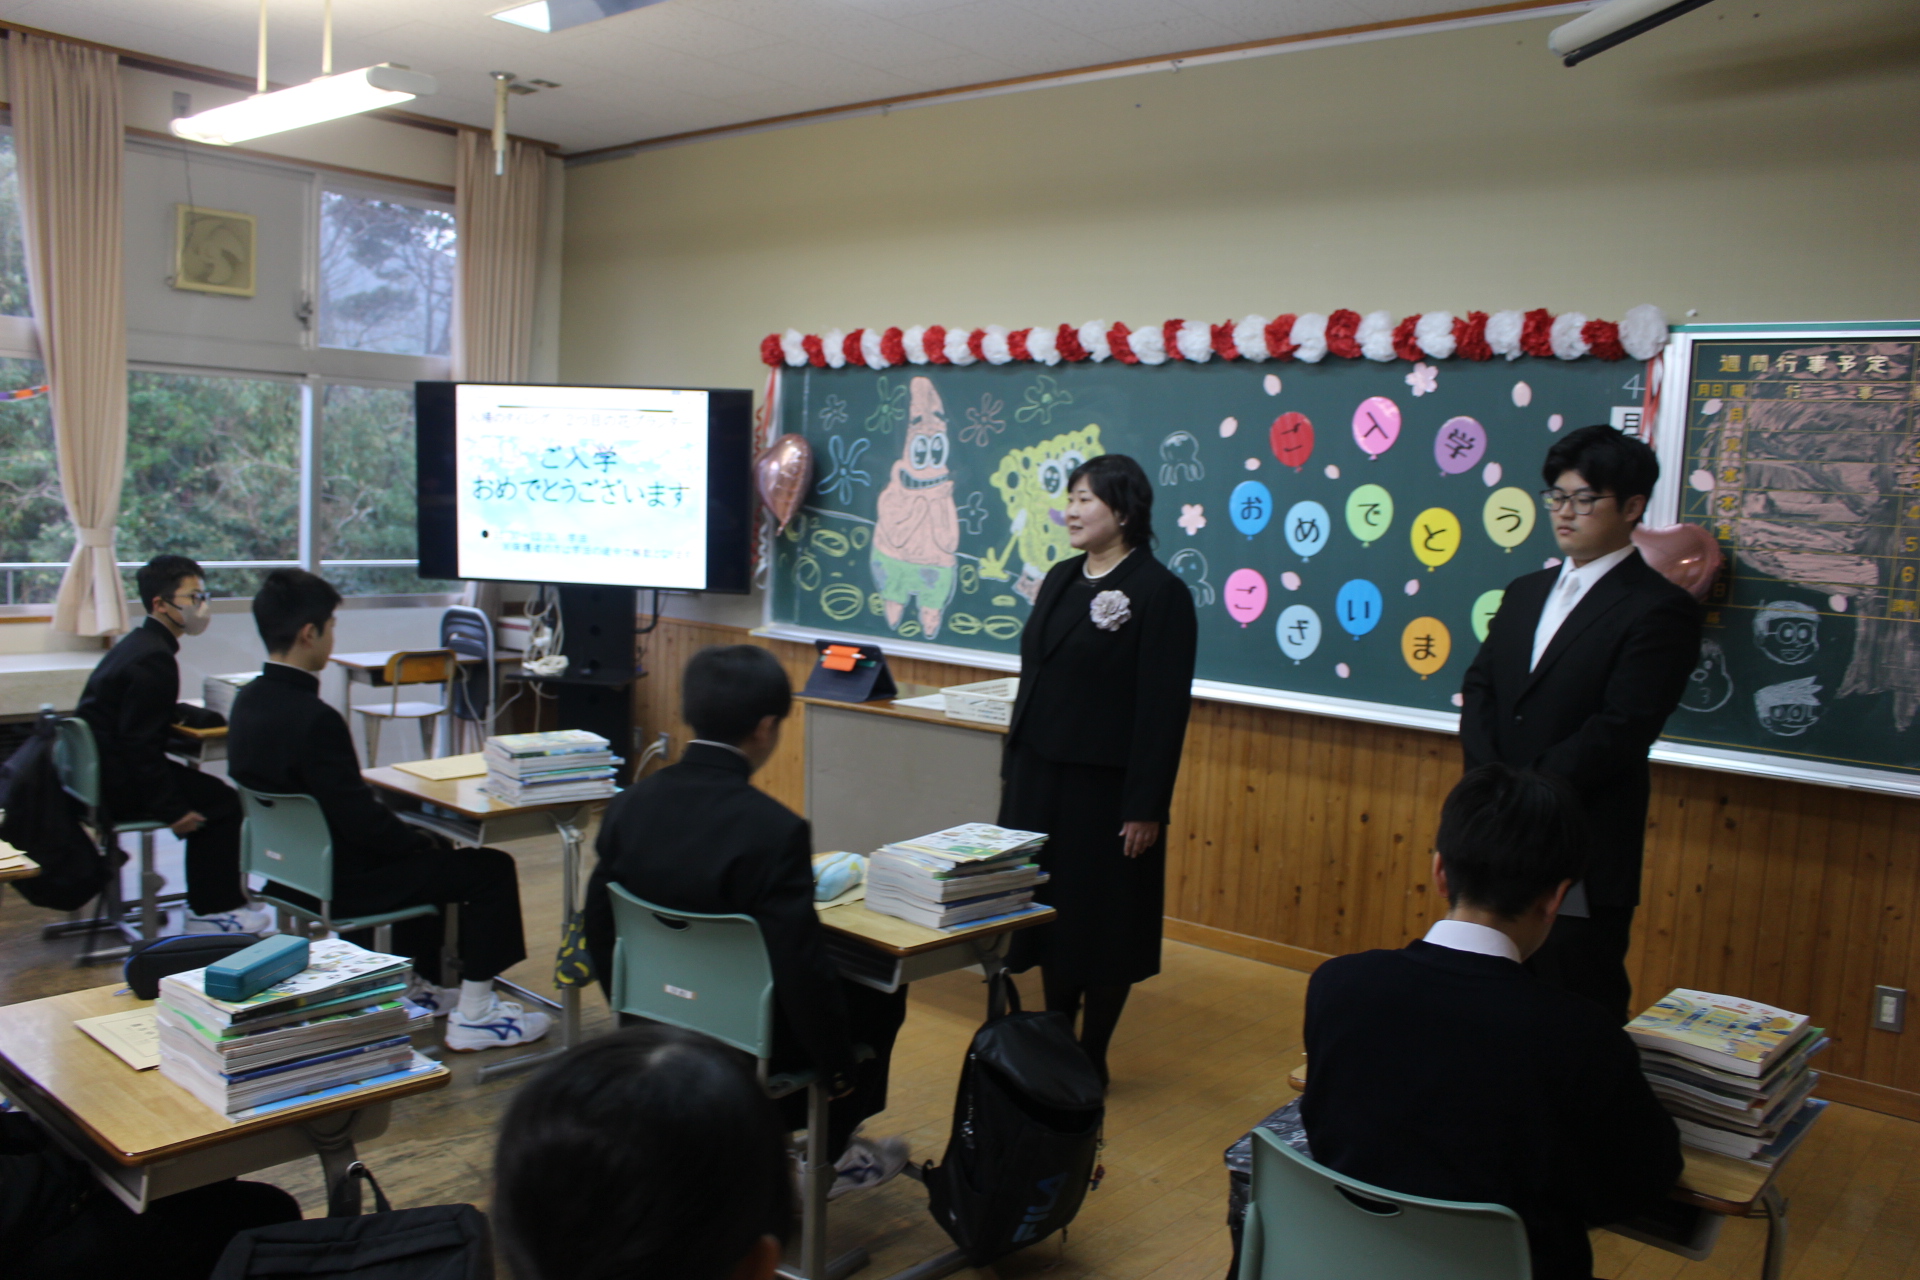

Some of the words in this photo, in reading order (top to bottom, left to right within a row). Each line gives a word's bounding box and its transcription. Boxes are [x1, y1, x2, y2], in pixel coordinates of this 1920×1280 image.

[1719, 354, 1890, 374] 週間行事予定
[540, 446, 618, 473] ご入学
[472, 475, 690, 508] おめでとうございます
[1905, 536, 1919, 552] 5
[1902, 566, 1916, 583] 6
